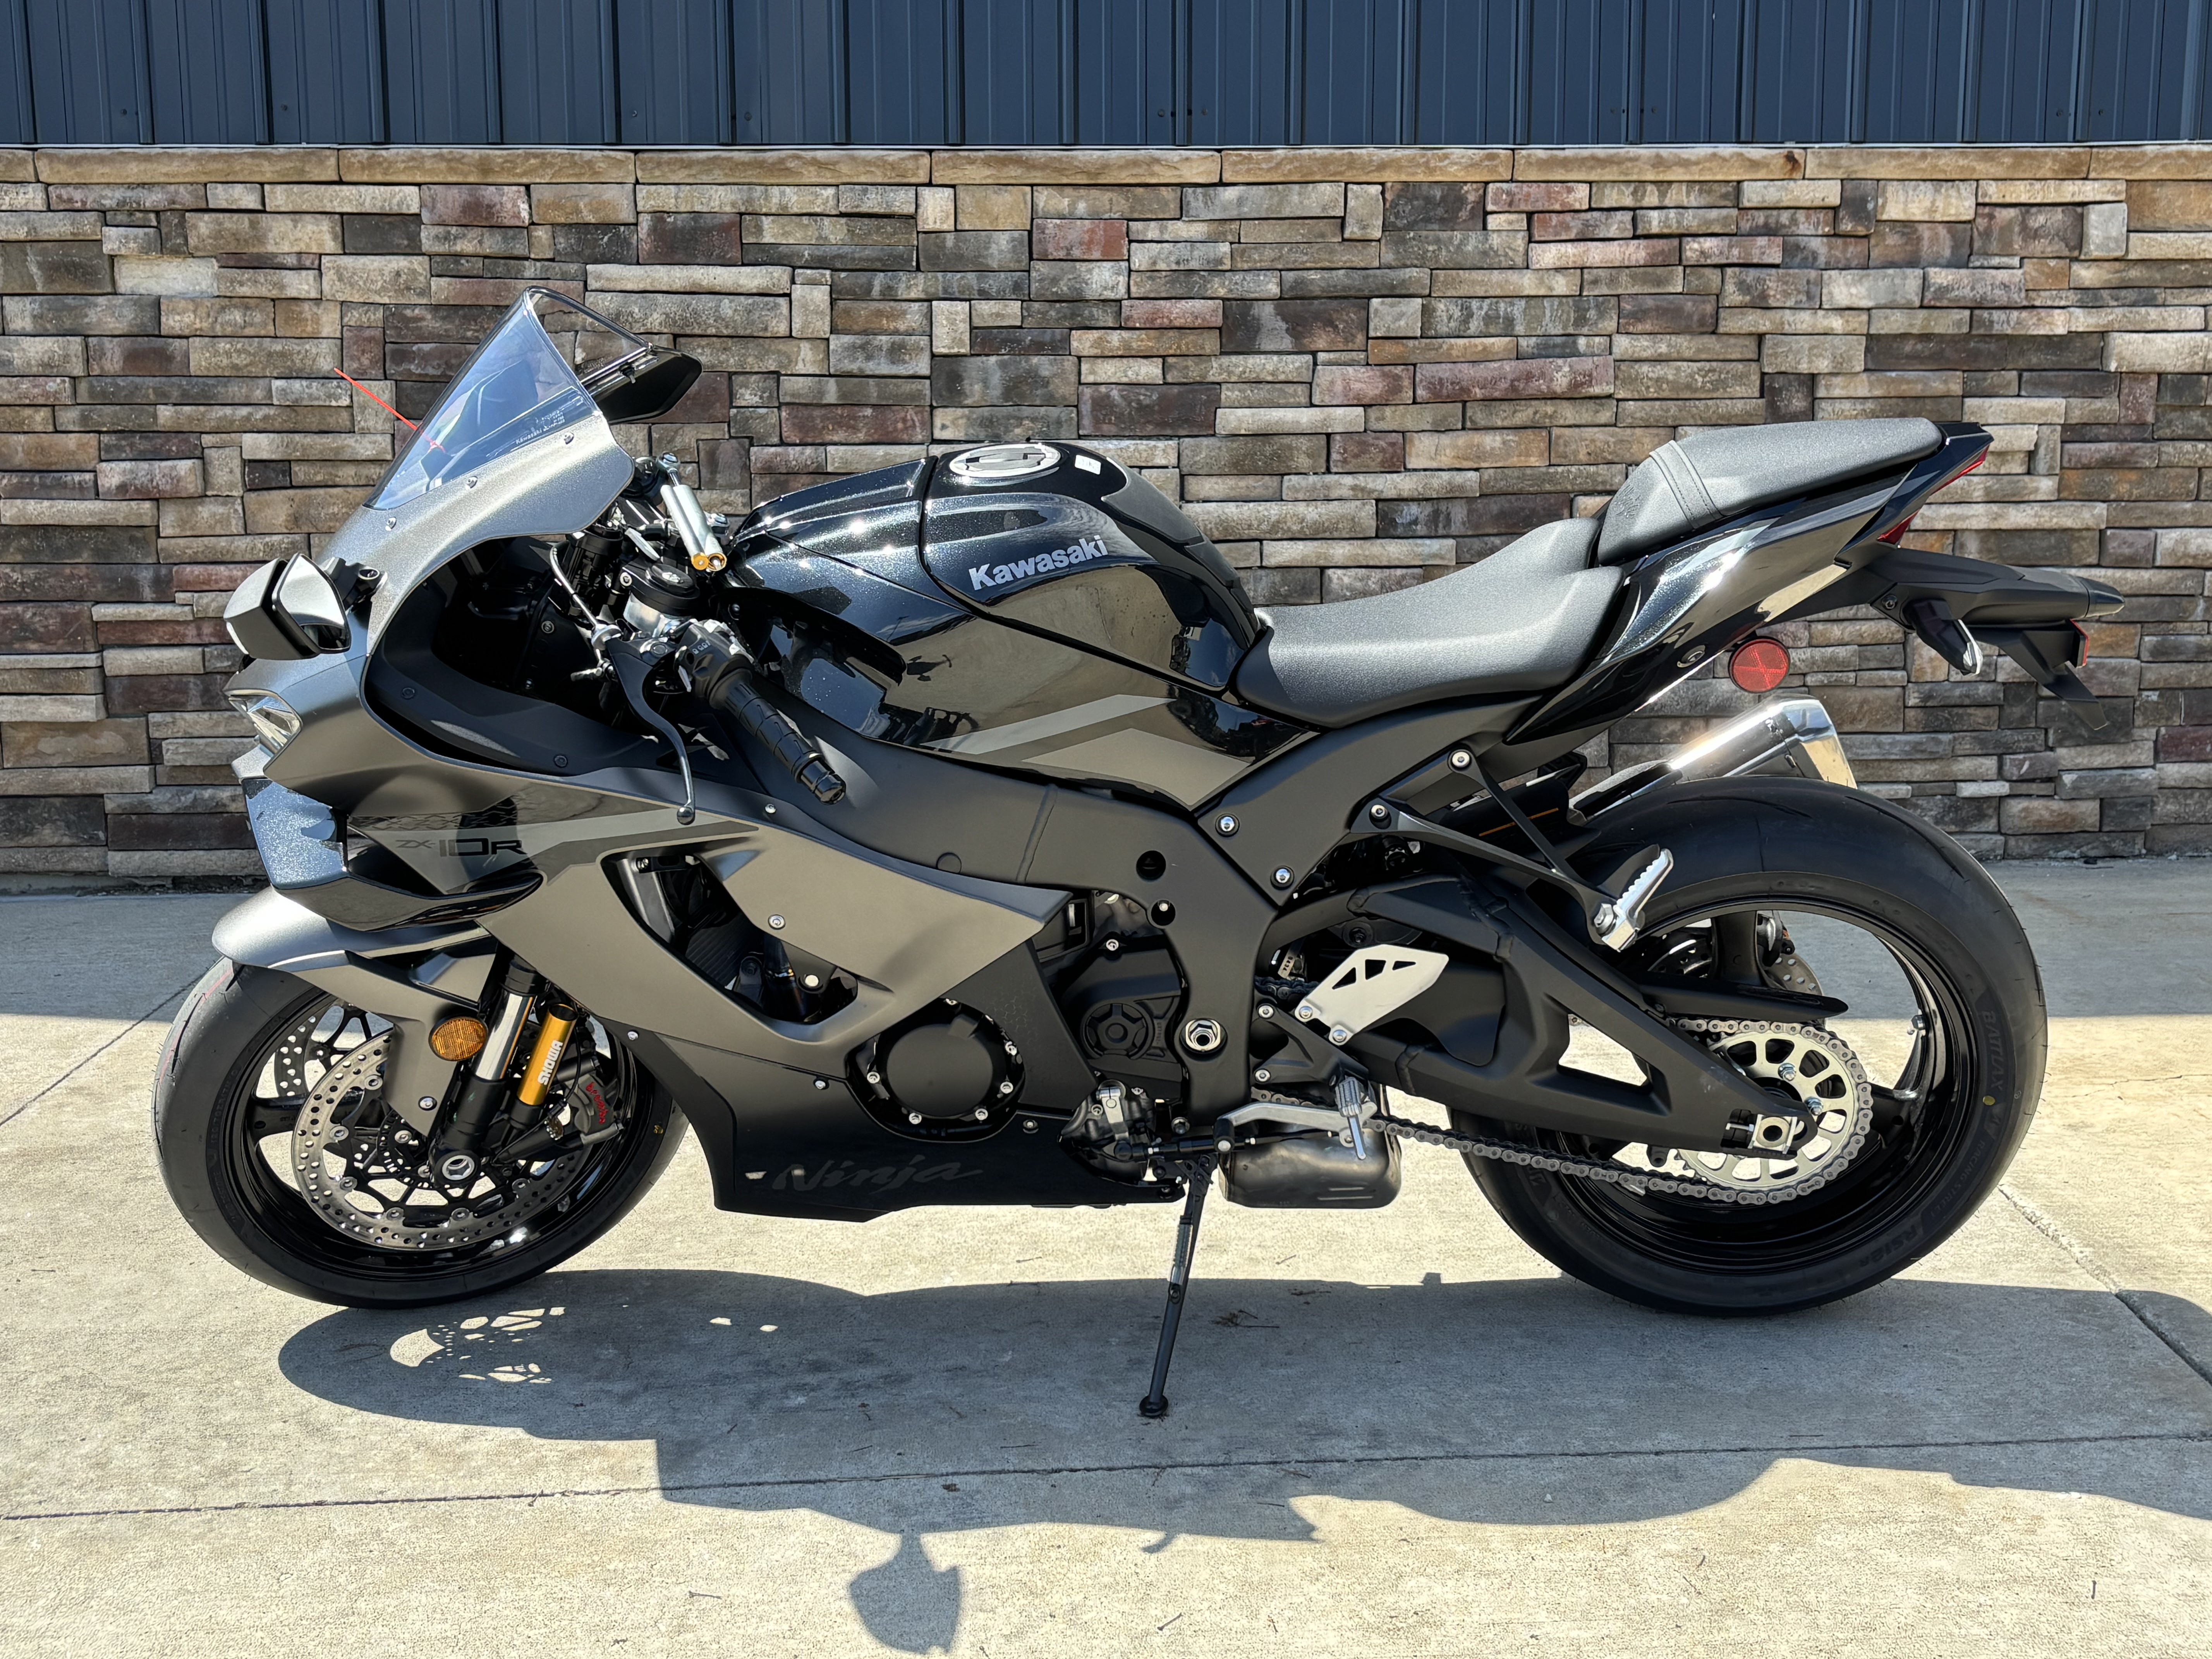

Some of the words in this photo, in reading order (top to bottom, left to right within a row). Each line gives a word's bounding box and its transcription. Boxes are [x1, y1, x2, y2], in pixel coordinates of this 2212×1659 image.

[515, 428, 542, 445] Kawasaki
[968, 534, 1108, 591] Kawasaki
[395, 838, 527, 857] ZX-10R
[537, 1039, 563, 1085] SHOWA
[1981, 1010, 2004, 1091] BATTLAX
[771, 1154, 984, 1195] Ninja
[1960, 1140, 1985, 1182] RACING
